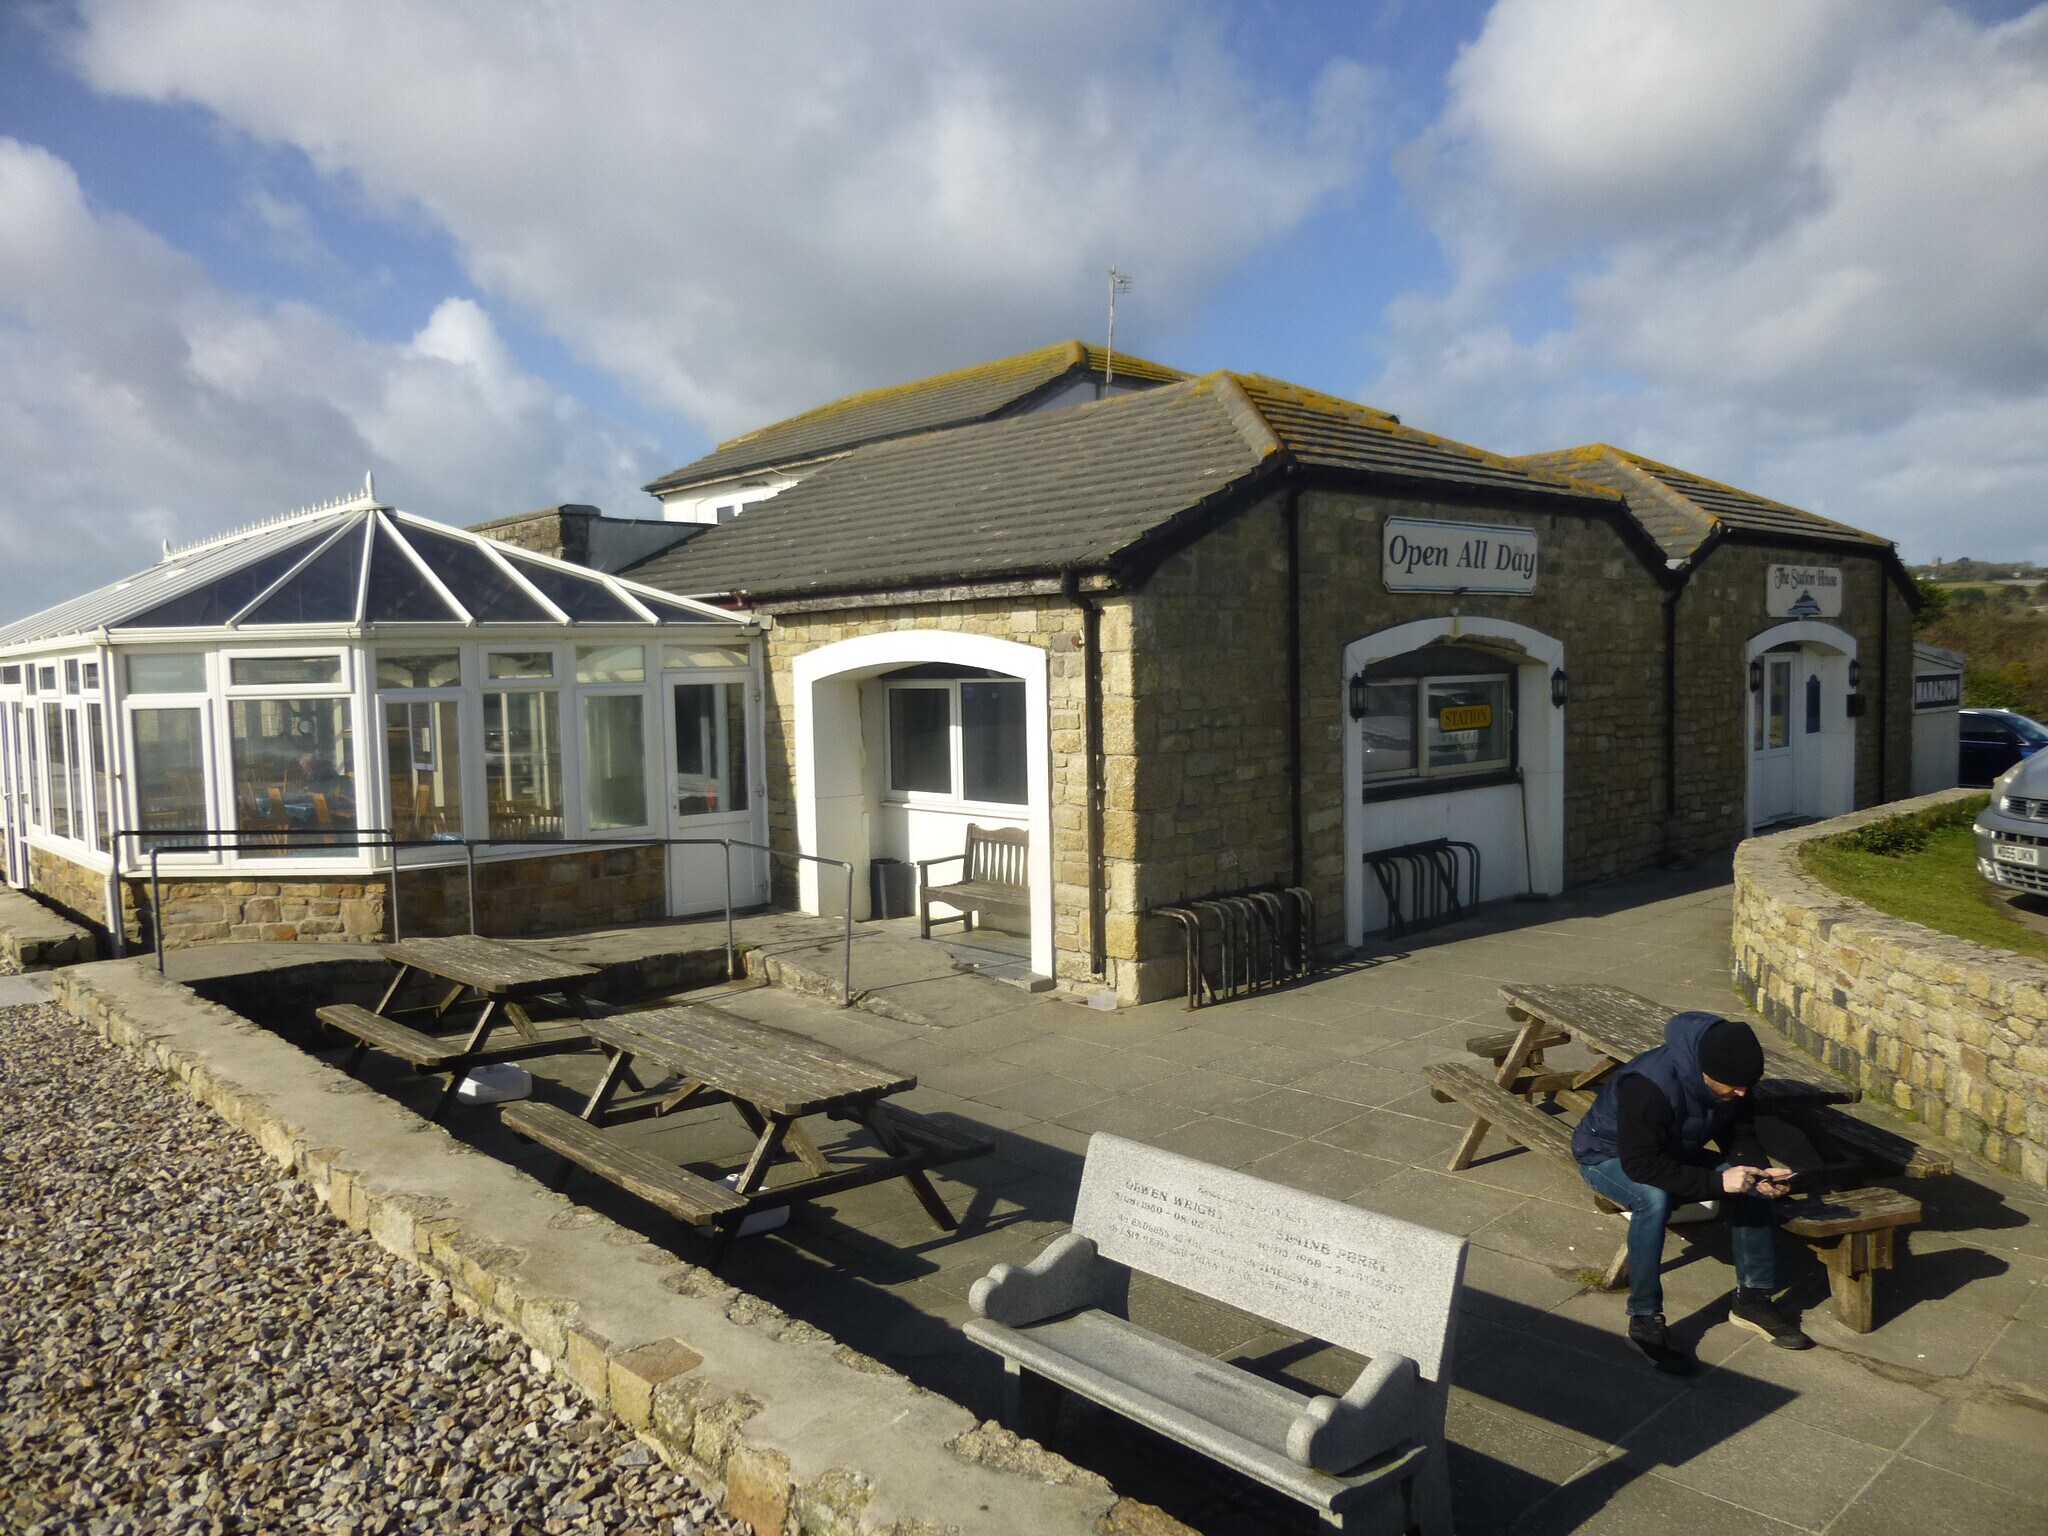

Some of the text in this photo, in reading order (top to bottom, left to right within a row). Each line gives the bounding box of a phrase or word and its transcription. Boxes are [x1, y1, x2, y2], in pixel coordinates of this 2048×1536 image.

[1389, 535, 1535, 580] Open All Day
[1774, 567, 1837, 589] The Station House
[1915, 679, 1958, 703] MARAZION
[1444, 708, 1488, 726] STATION
